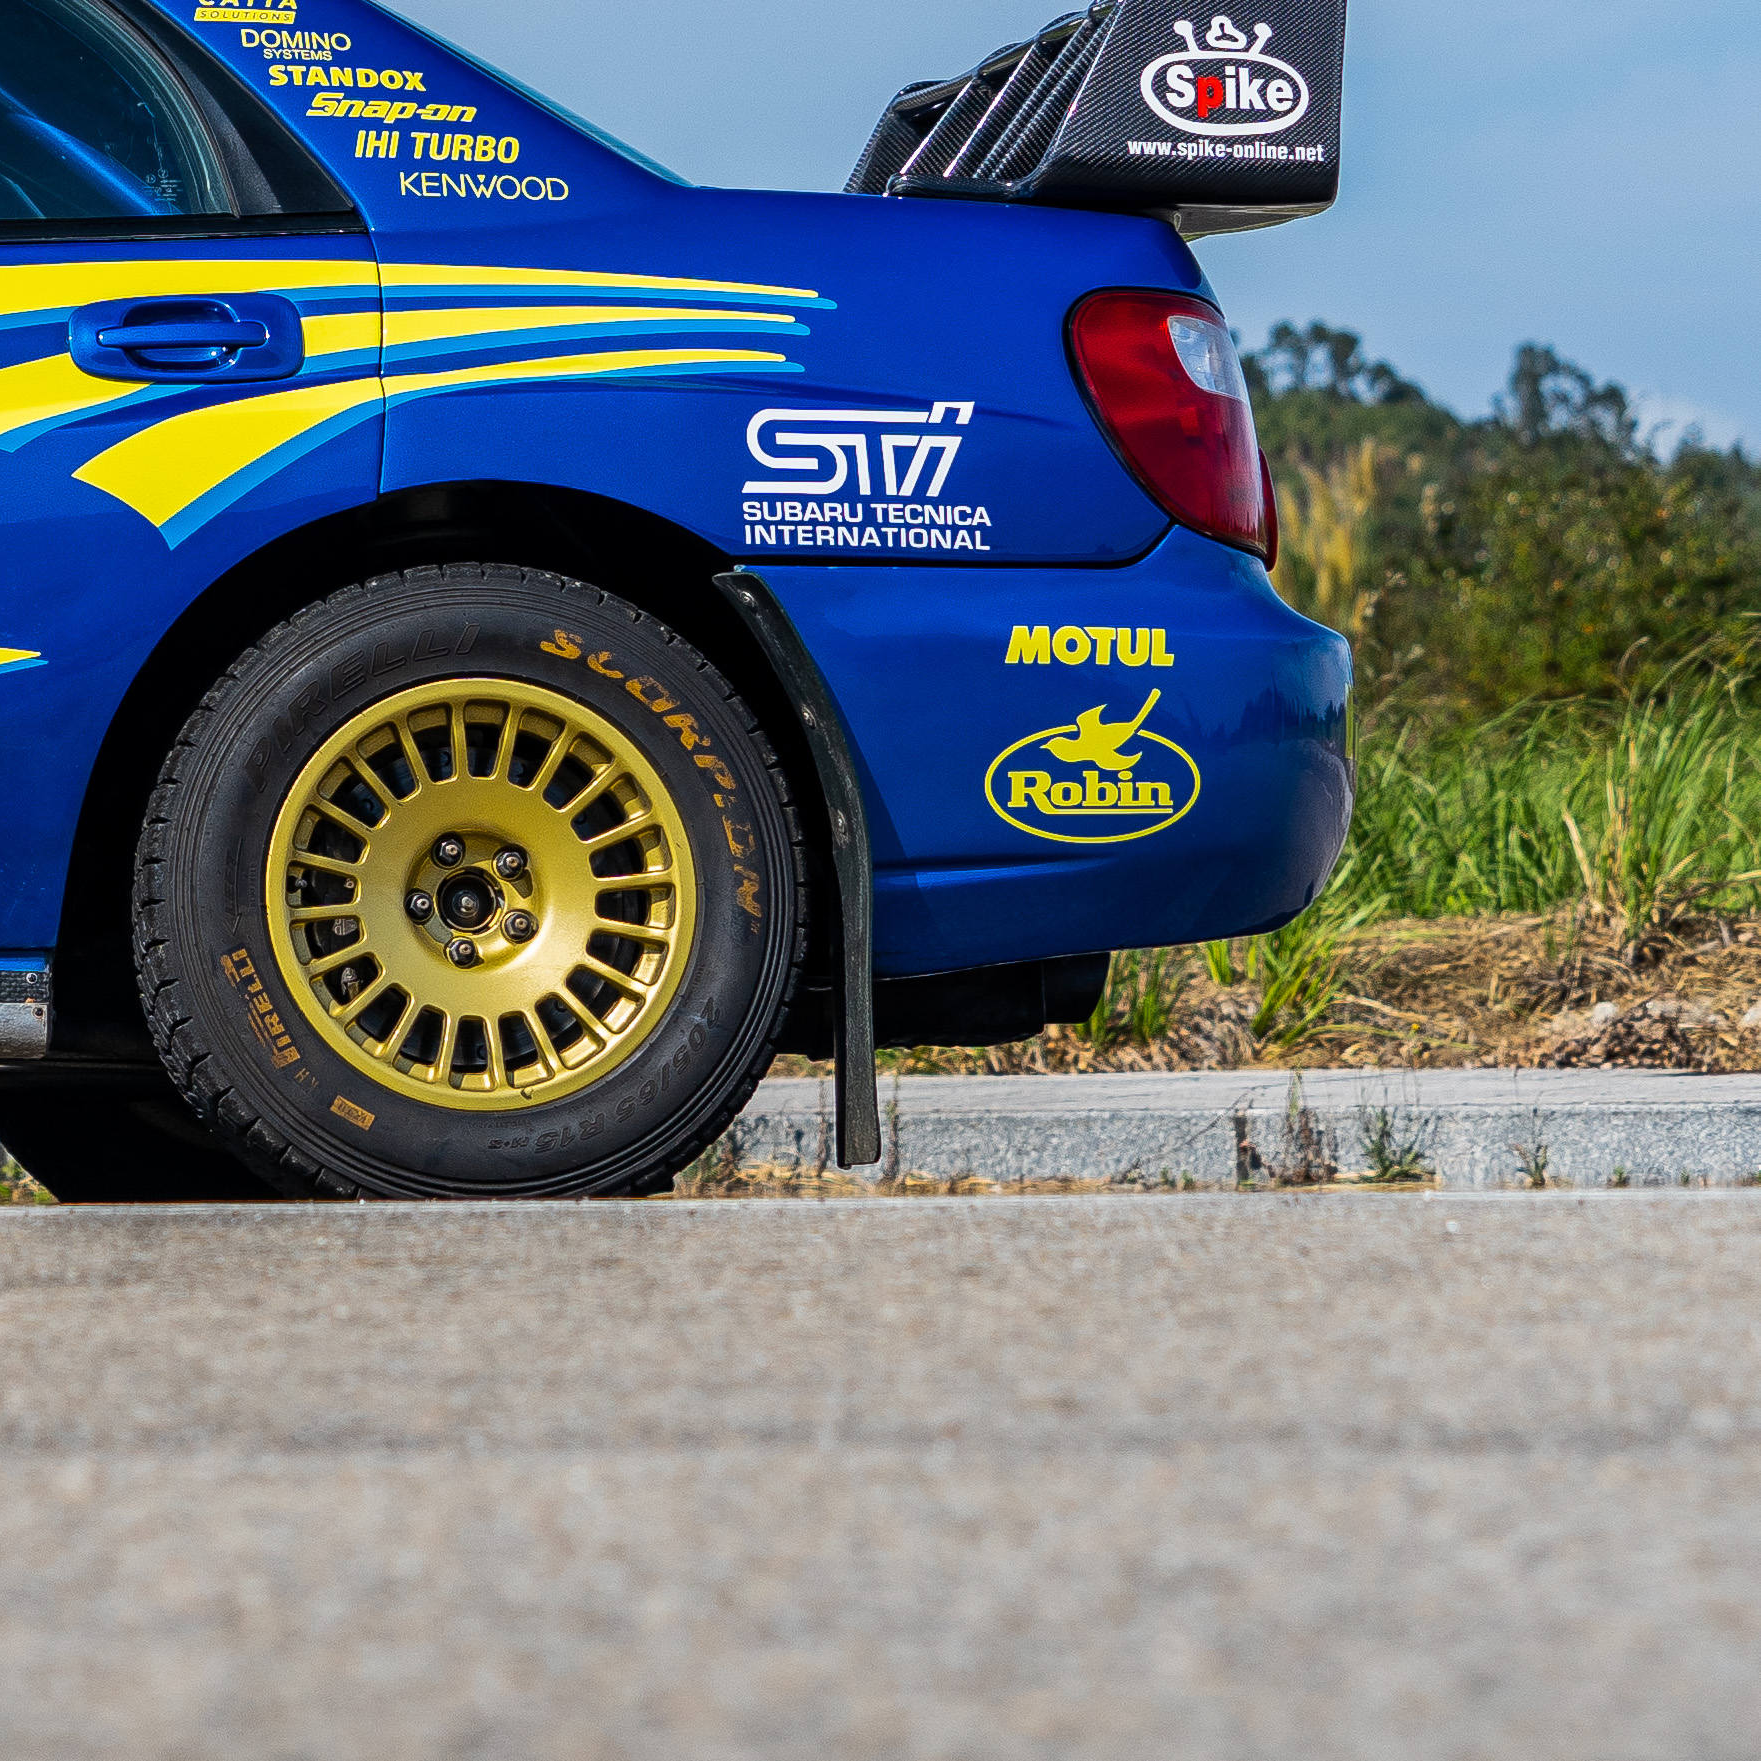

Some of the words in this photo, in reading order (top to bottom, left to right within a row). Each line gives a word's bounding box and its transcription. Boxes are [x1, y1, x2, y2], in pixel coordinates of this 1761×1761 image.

[199, 10, 292, 21] SOLUTIONS
[240, 28, 352, 52] DOMINO
[262, 48, 333, 62] SYSTEMS
[268, 64, 427, 92] STANDOX
[1165, 65, 1294, 118] Spike
[305, 91, 478, 124] Snap-on
[354, 129, 400, 159] IHI
[410, 131, 520, 165] TURBO
[1127, 139, 1325, 162] www.spike-online.net
[399, 171, 570, 201] KENWOOD
[742, 500, 863, 524] SUBARU
[870, 503, 992, 527] TECNICA
[743, 524, 991, 551] INTERNATIONAL
[1004, 624, 1175, 667] MOTUL
[244, 623, 479, 792] PIRELLI
[1007, 769, 1174, 815] Robin
[220, 948, 301, 1070] PIRELLI
[616, 996, 721, 1123] 205/65
[534, 1113, 605, 1154] R15
